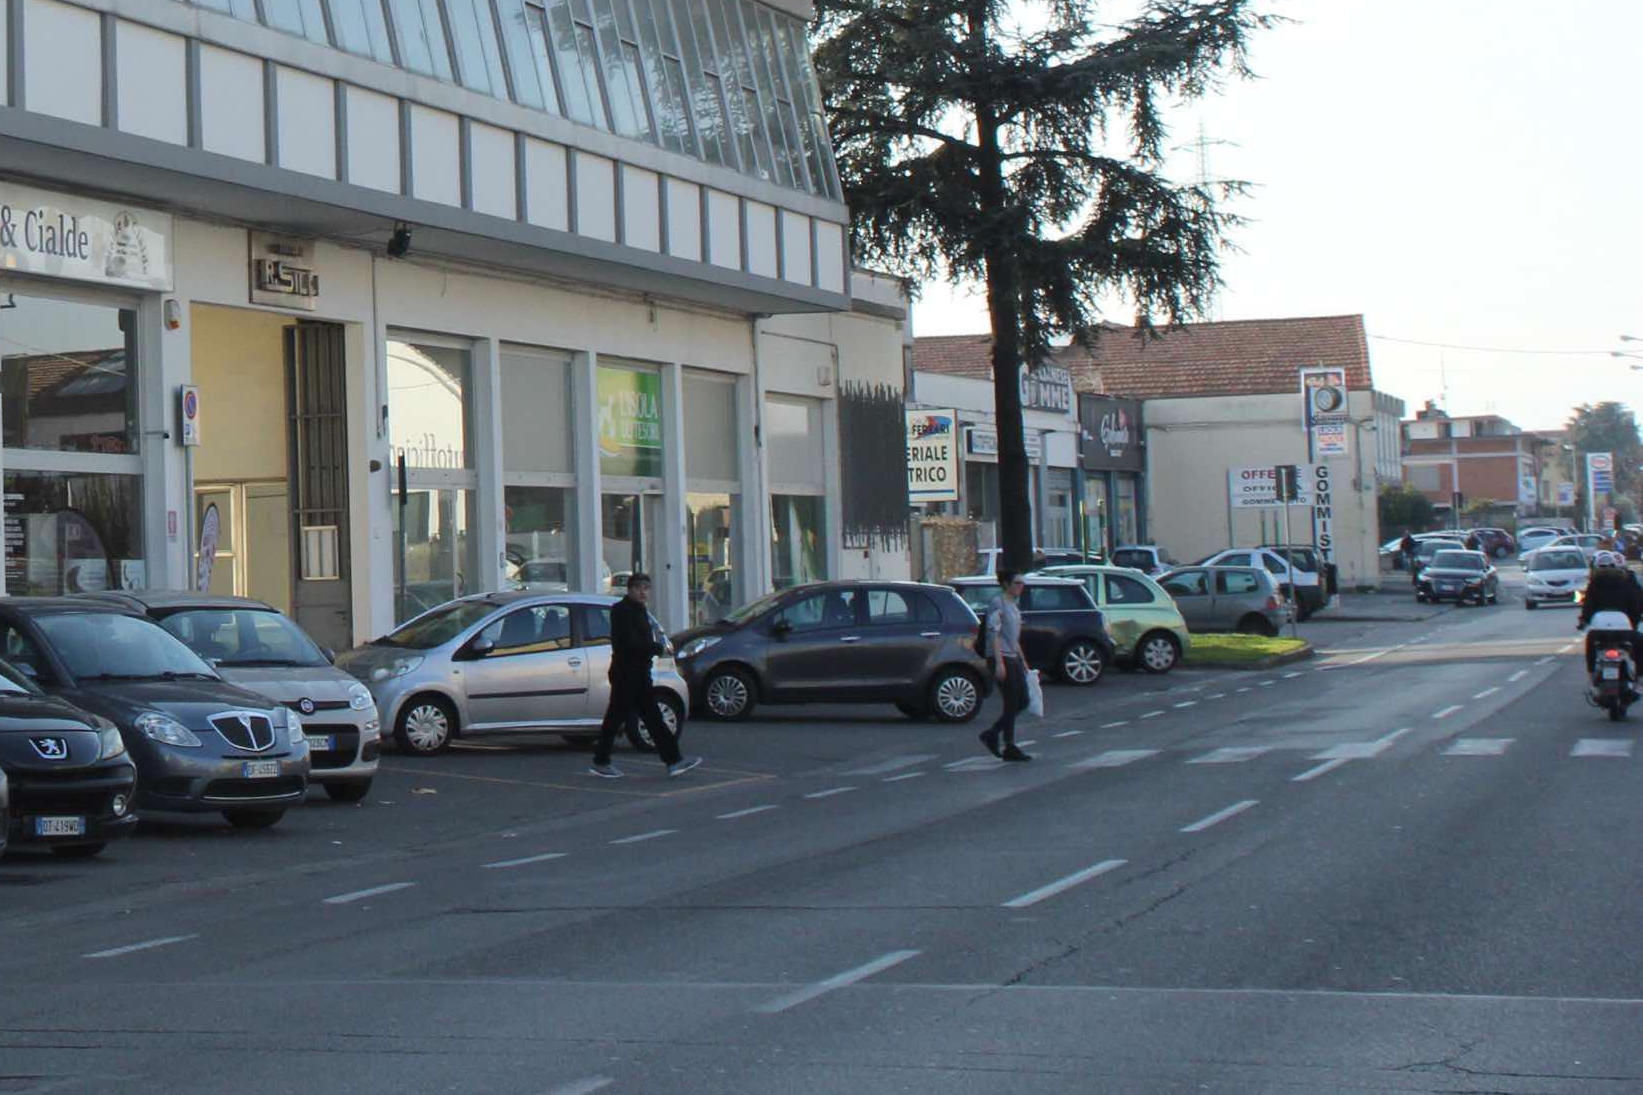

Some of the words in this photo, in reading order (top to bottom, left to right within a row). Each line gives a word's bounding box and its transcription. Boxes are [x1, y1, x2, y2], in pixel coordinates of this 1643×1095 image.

[0, 205, 18, 248] &
[25, 210, 88, 261] Cialde
[1241, 468, 1302, 480] OFFEE
